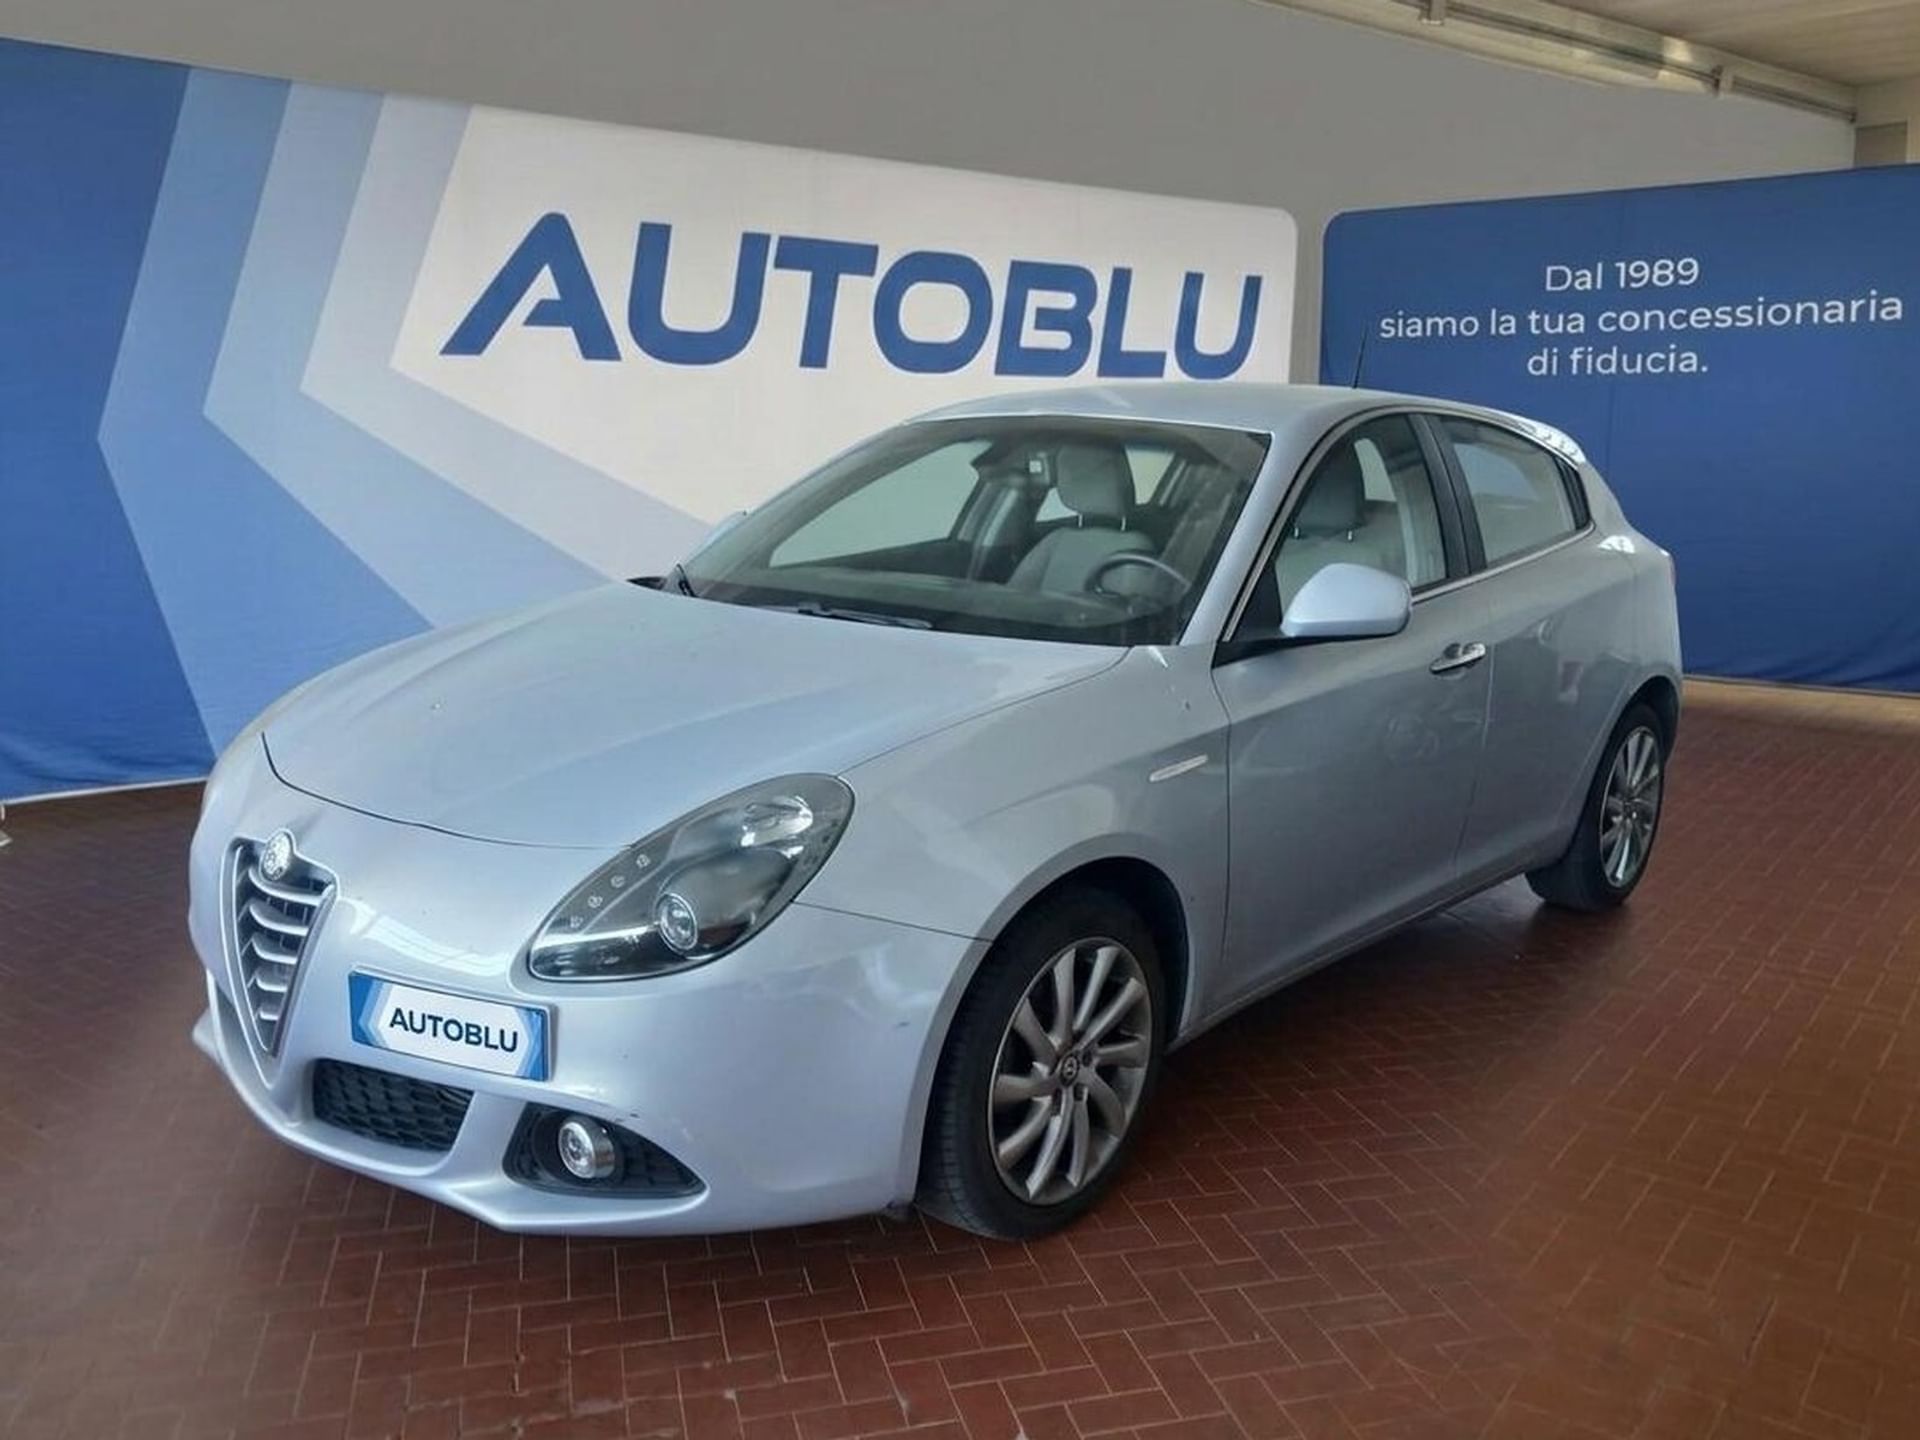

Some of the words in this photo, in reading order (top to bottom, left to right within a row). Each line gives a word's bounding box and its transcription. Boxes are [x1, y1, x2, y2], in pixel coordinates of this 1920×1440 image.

[438, 211, 1264, 380] AUTOBLU
[1545, 262, 1603, 292] Dal
[1615, 256, 1700, 290] 1989
[1379, 309, 1480, 339] siamo
[1490, 307, 1517, 337] la
[1528, 308, 1586, 336] tua
[1598, 288, 1903, 332] concessionaria
[1527, 347, 1559, 376] di
[1569, 342, 1709, 375] fiducia.
[389, 1007, 519, 1053] AUTOBLU
